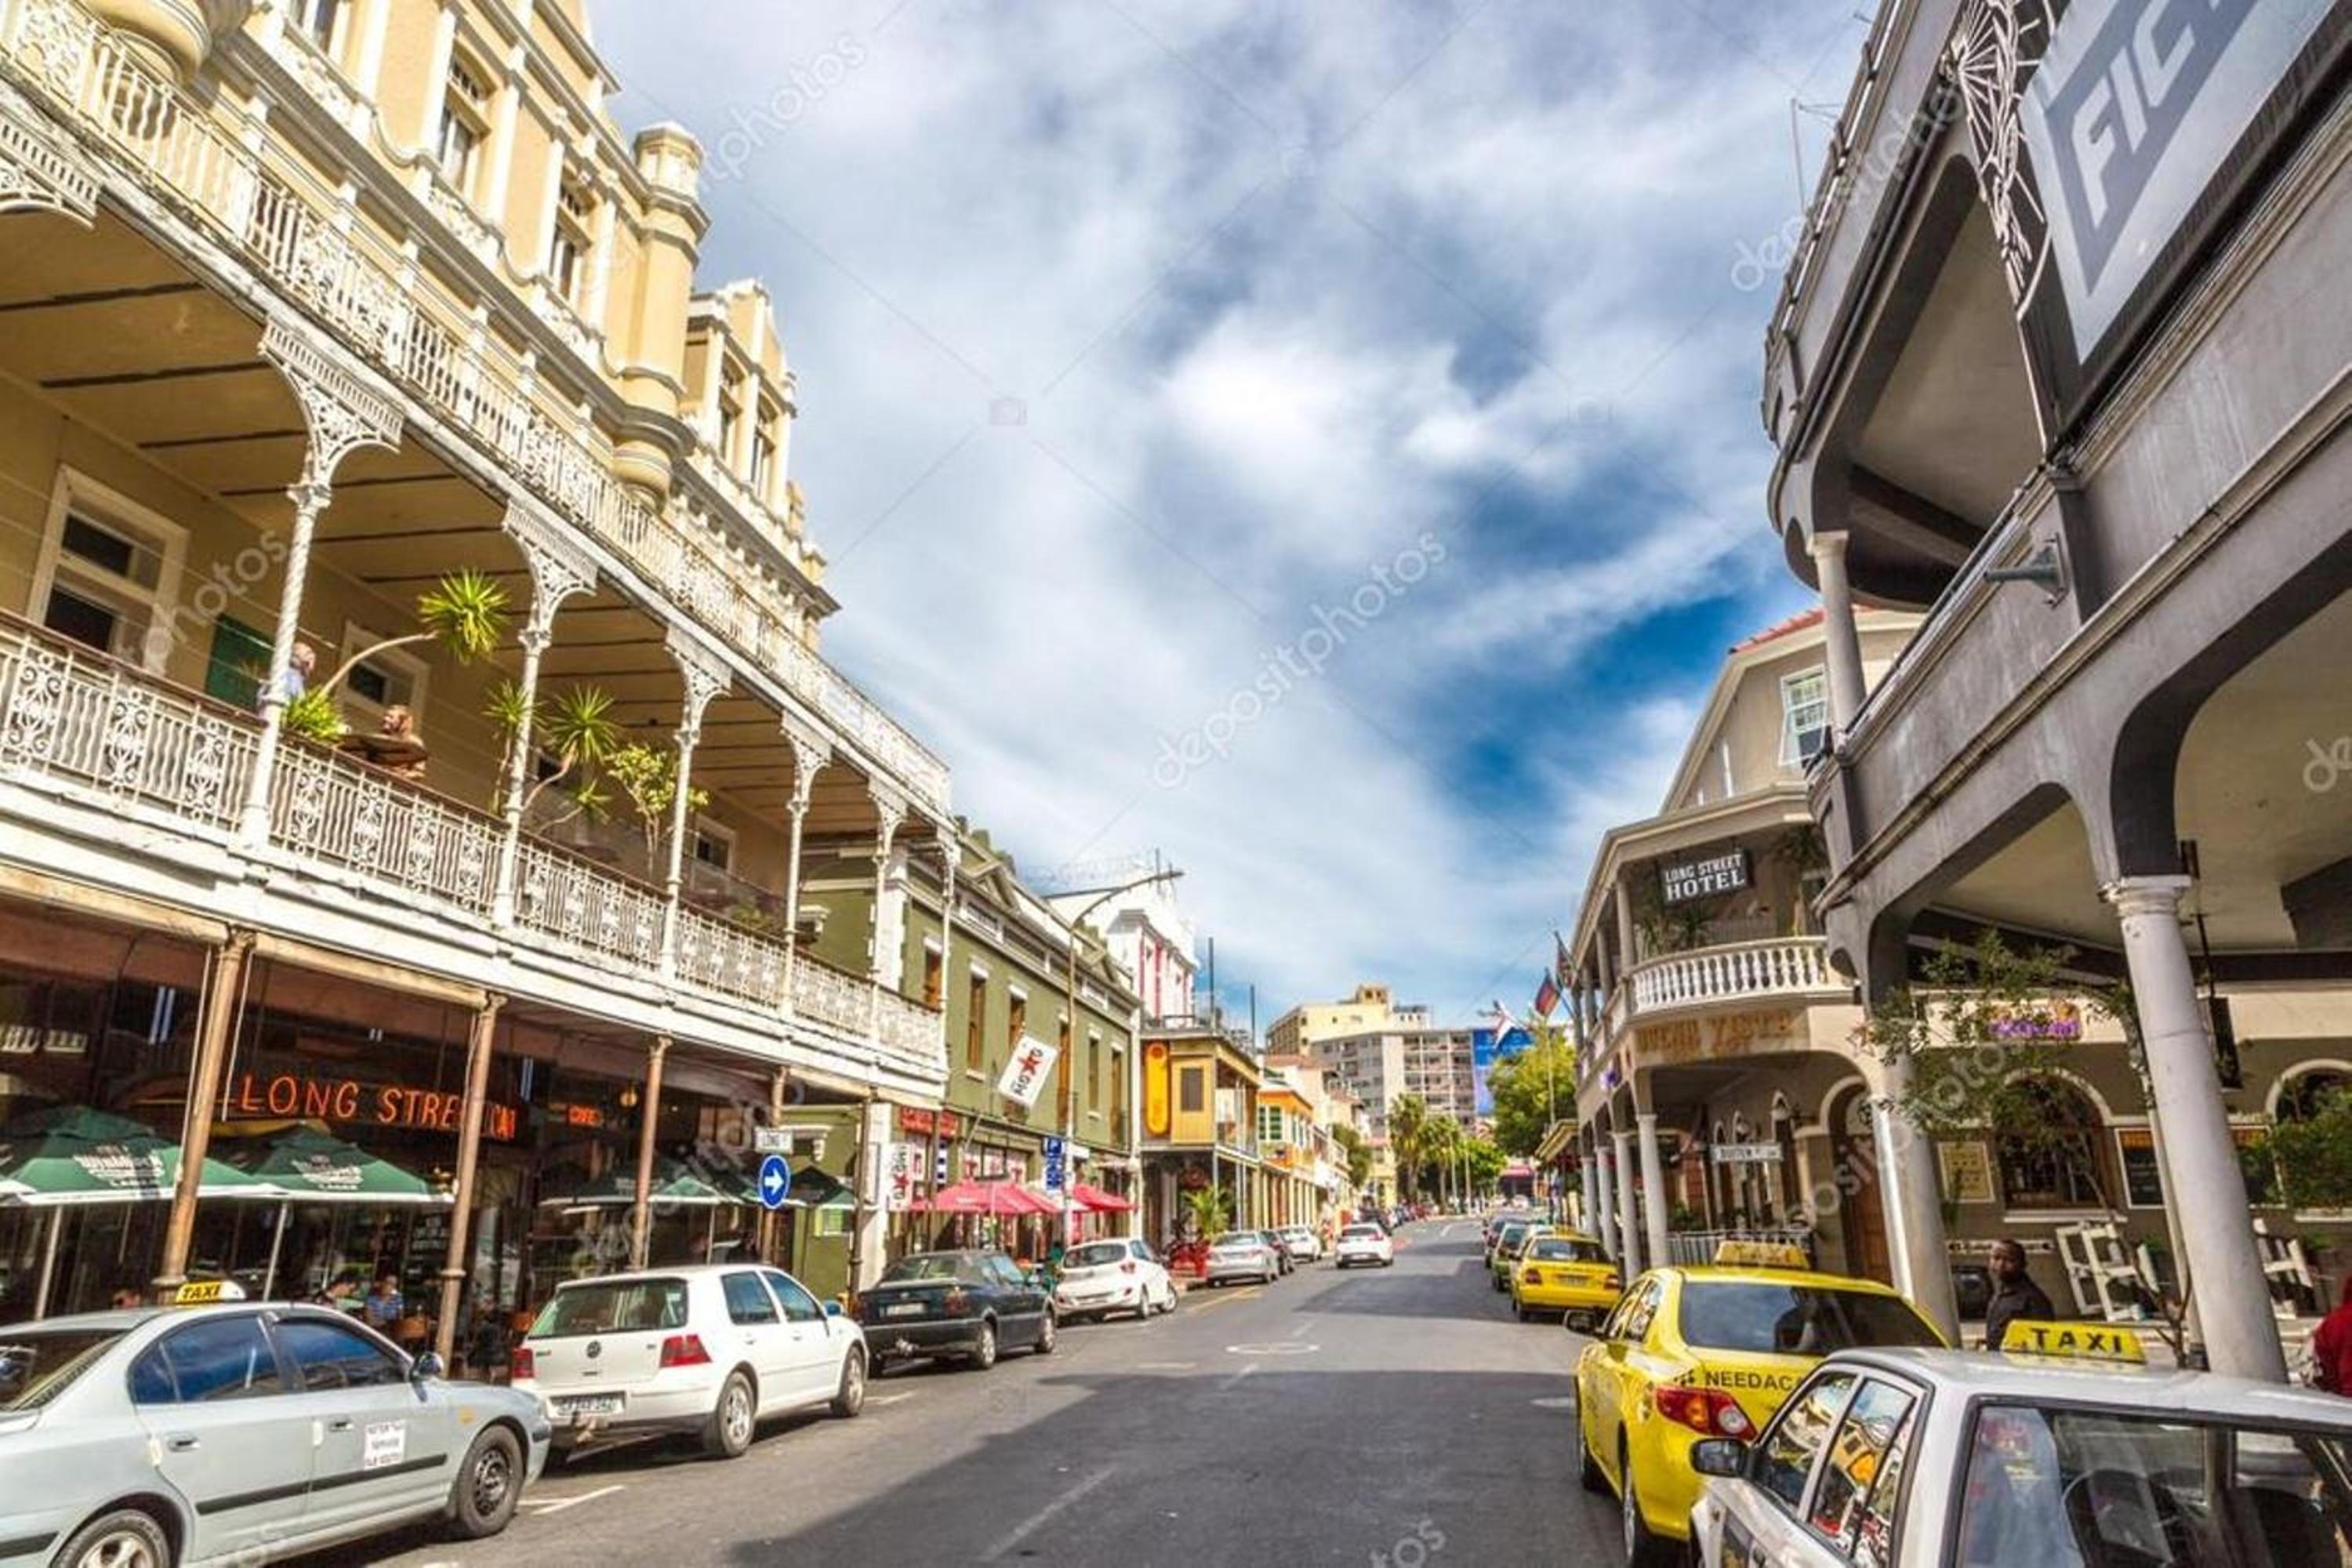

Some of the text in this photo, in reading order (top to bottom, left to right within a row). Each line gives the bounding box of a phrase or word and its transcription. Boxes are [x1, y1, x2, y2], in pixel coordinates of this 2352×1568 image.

[1665, 853, 1742, 883] LONG STREET
[1667, 869, 1745, 902] HOTEL
[240, 1074, 359, 1119] LONG
[376, 1086, 472, 1131] STRE
[181, 1285, 221, 1299] TAXI
[2028, 1328, 2123, 1353] TAXI
